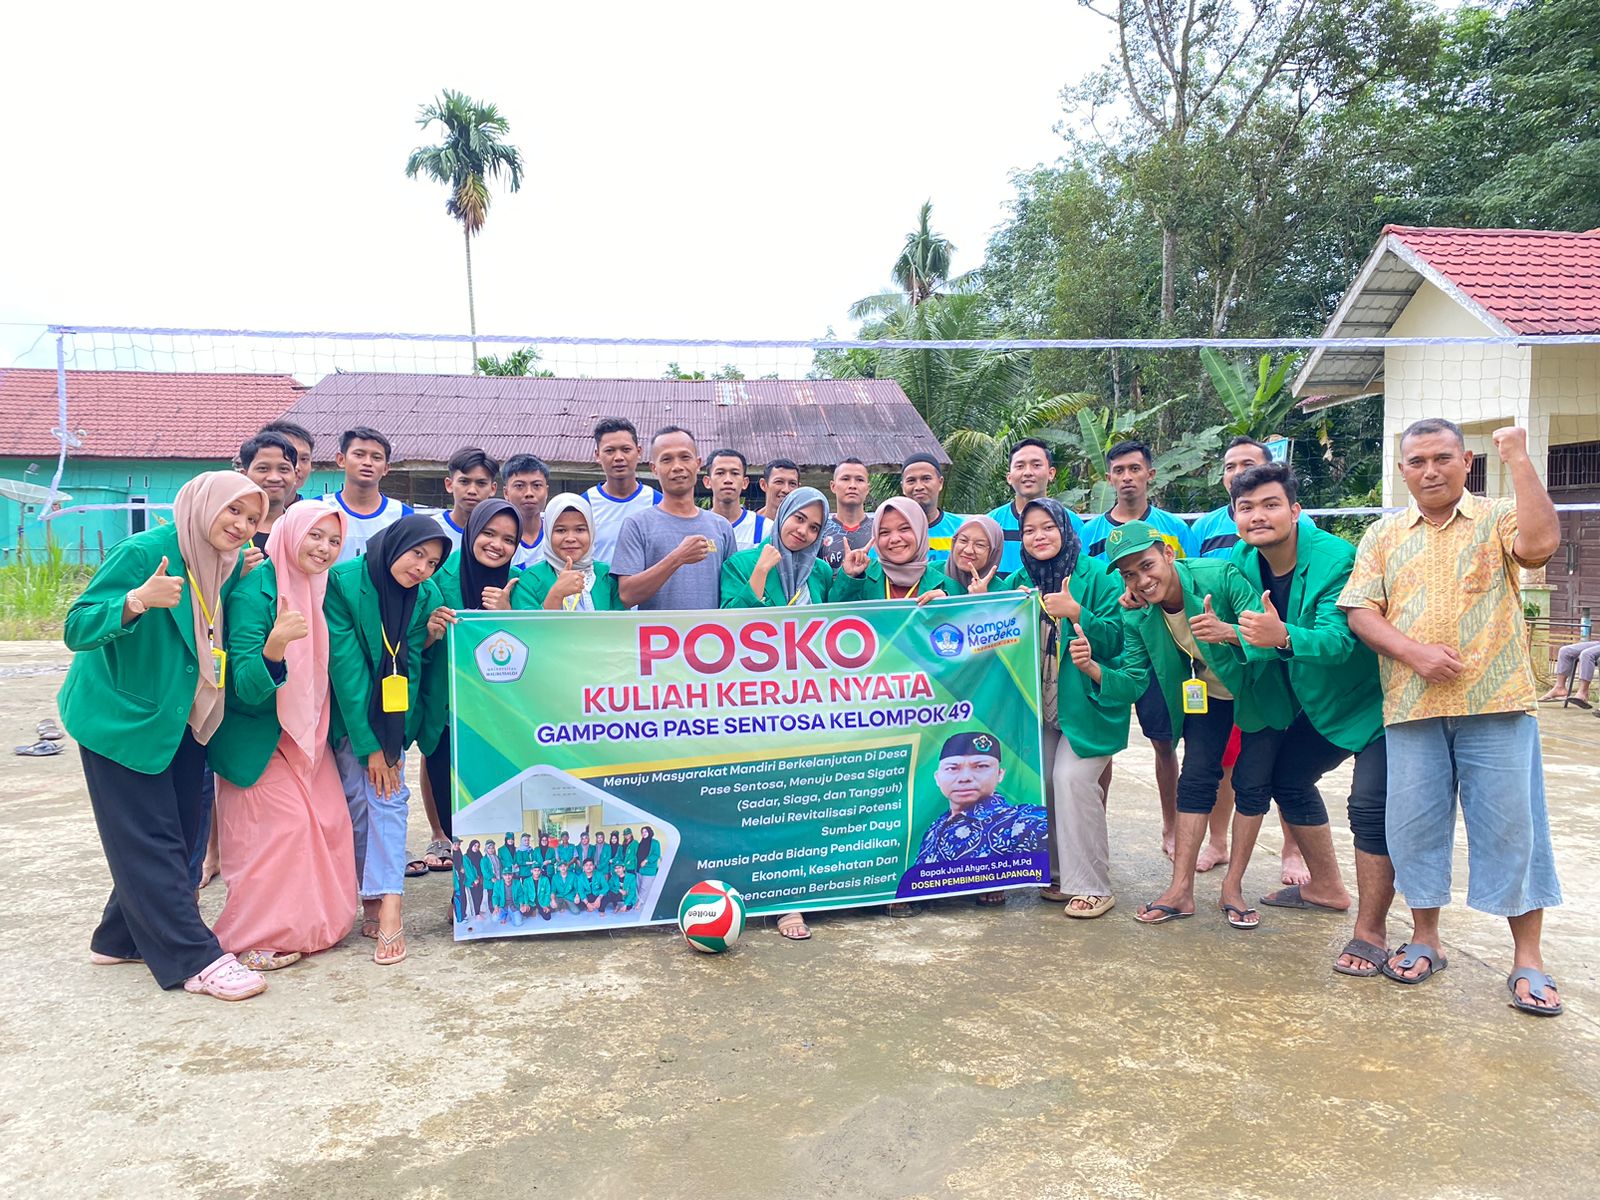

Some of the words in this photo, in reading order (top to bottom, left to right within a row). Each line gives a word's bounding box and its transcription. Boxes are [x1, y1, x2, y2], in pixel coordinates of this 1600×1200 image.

[967, 617, 1016, 635] Kampus
[967, 628, 1021, 647] Merdeka
[638, 618, 874, 677] POSKO
[583, 683, 707, 714] KULIAH
[717, 678, 822, 707] KERJA
[830, 674, 934, 702] NYATA
[537, 721, 658, 743] GAMPONG
[664, 719, 719, 736] PASE
[724, 713, 826, 734] SENTOSA
[830, 709, 945, 729] KELOMPOK
[949, 702, 971, 720] 49
[603, 773, 649, 788] Menuju
[651, 766, 727, 783] Masyarakat
[729, 760, 776, 775] Mandiri
[778, 753, 862, 771] Berkelanjutan
[864, 751, 876, 761] Di
[878, 748, 907, 760] Desa
[700, 785, 731, 796] Pase
[733, 779, 787, 793] Sentosa,
[789, 773, 833, 787] Menuju
[835, 771, 865, 782] Desa
[867, 766, 905, 778] Sigata
[736, 798, 781, 812] (Sadar,
[783, 793, 821, 806] Siaga,
[823, 790, 847, 801] dan
[848, 782, 903, 798] Tangguh)
[741, 813, 785, 827] Melalui
[787, 805, 857, 821] Revitalisasi
[858, 799, 902, 813] Potensi
[821, 824, 868, 837] Sumber
[869, 818, 902, 832] Daya
[697, 854, 750, 871] Manusia
[751, 850, 785, 864] Pada
[786, 846, 829, 860] Bidang
[830, 838, 901, 854] Pendidikan,
[751, 865, 807, 883] Ekonomi,
[808, 859, 875, 876] Kesehatan
[876, 854, 899, 866] Dan
[920, 869, 946, 878] Bapak
[948, 864, 964, 874] Juni
[965, 862, 991, 875] Ahyar,
[1012, 857, 1032, 867] M.Pd
[808, 880, 861, 893] Berbasis
[863, 872, 898, 887] Risert
[911, 880, 941, 890] DOSEN
[942, 874, 996, 886] PEMBIMBING
[996, 869, 1042, 880] LAPANGAN
